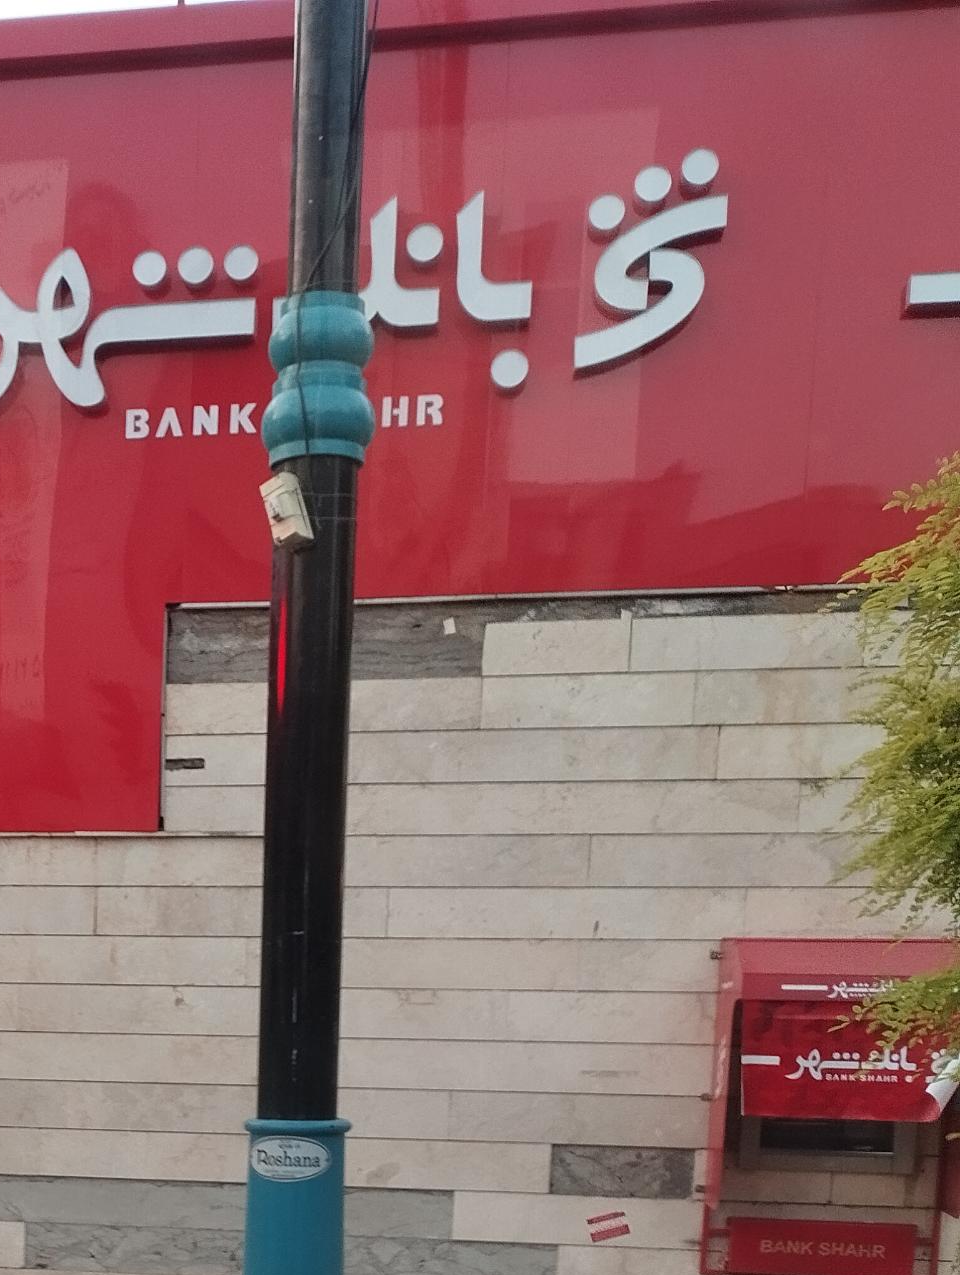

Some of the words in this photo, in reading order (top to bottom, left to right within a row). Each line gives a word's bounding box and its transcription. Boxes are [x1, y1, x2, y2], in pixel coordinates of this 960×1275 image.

[124, 403, 259, 441] BANK
[784, 1048, 860, 1081] شهر
[859, 1074, 899, 1084] SHAHR
[256, 1148, 321, 1169] Roshana
[759, 1239, 814, 1256] BANK
[817, 1241, 887, 1260] SHAHR
